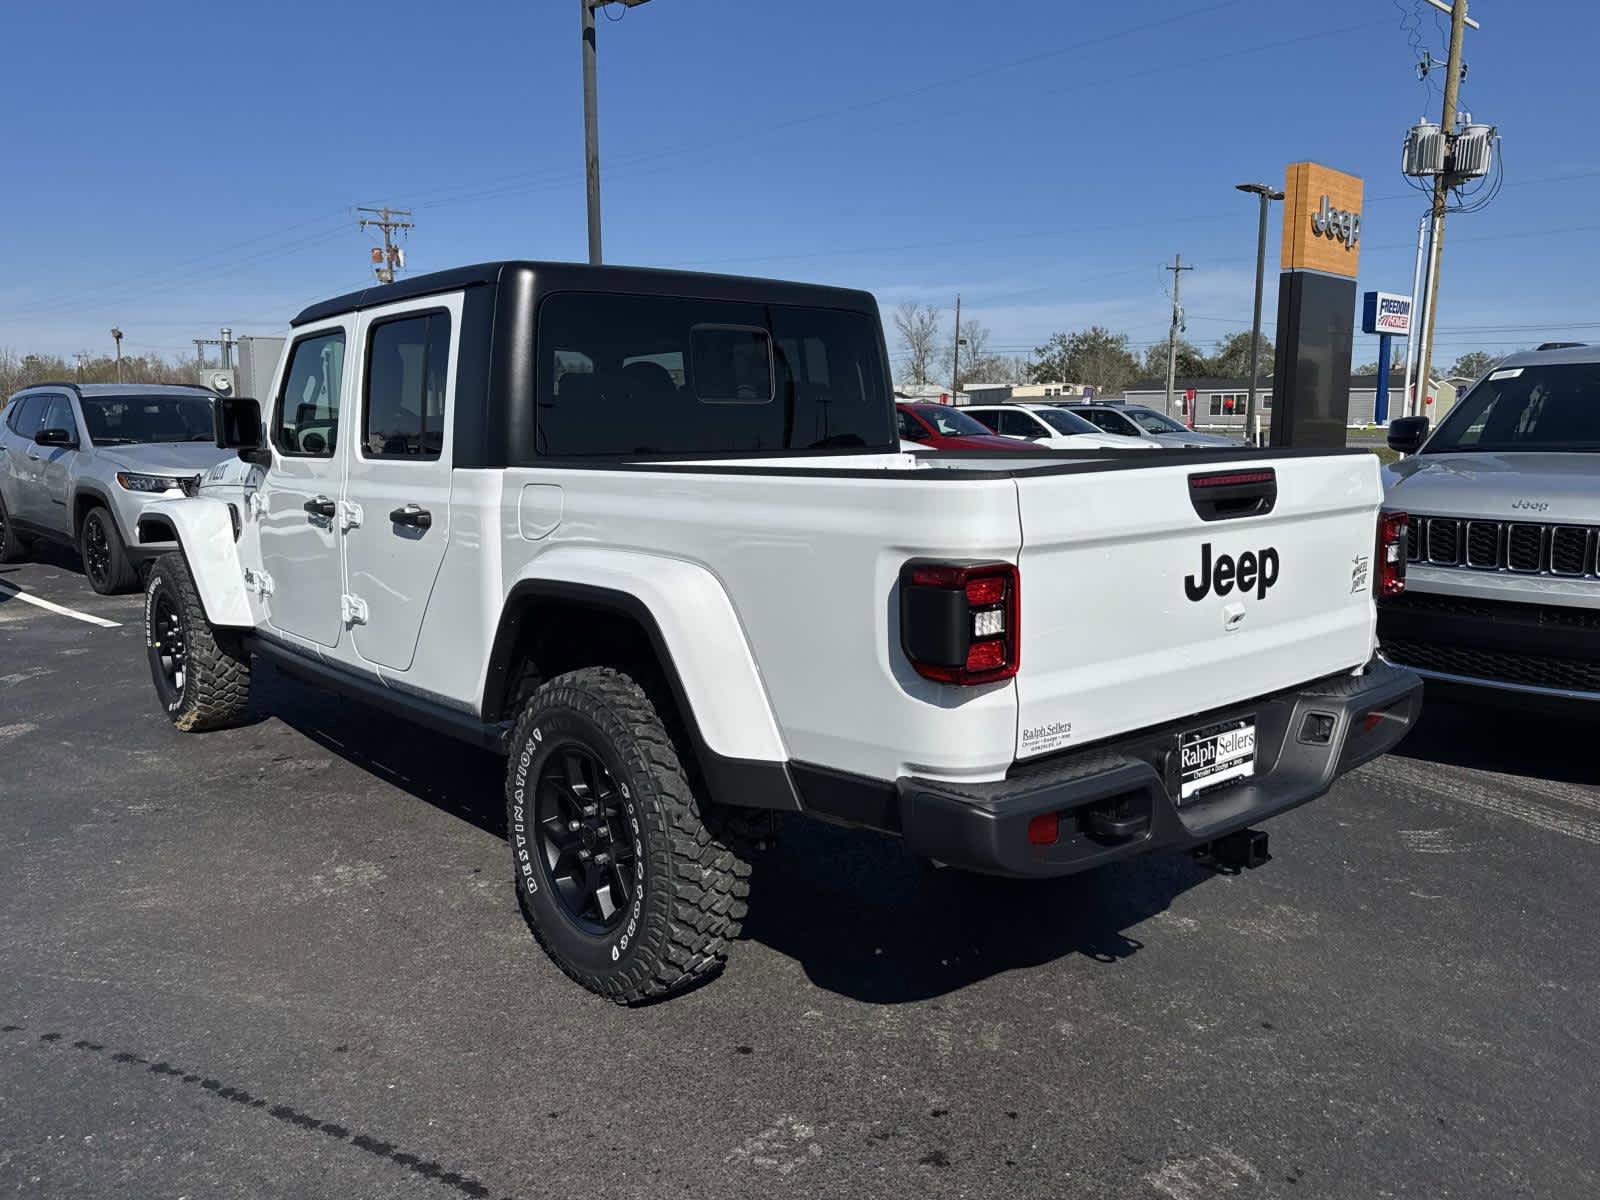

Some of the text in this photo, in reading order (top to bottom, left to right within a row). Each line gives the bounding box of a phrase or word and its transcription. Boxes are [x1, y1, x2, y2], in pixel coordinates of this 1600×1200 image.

[1310, 195, 1361, 252] Jeep
[1379, 298, 1411, 316] FREEDOM
[1511, 498, 1549, 512] Jeep
[1184, 543, 1280, 602] Jeep
[1351, 561, 1368, 580] WHEEL
[1022, 721, 1072, 741] Ralph Sellers
[1181, 732, 1254, 769] Ralph Sellers
[513, 740, 539, 895] DESTINATION
